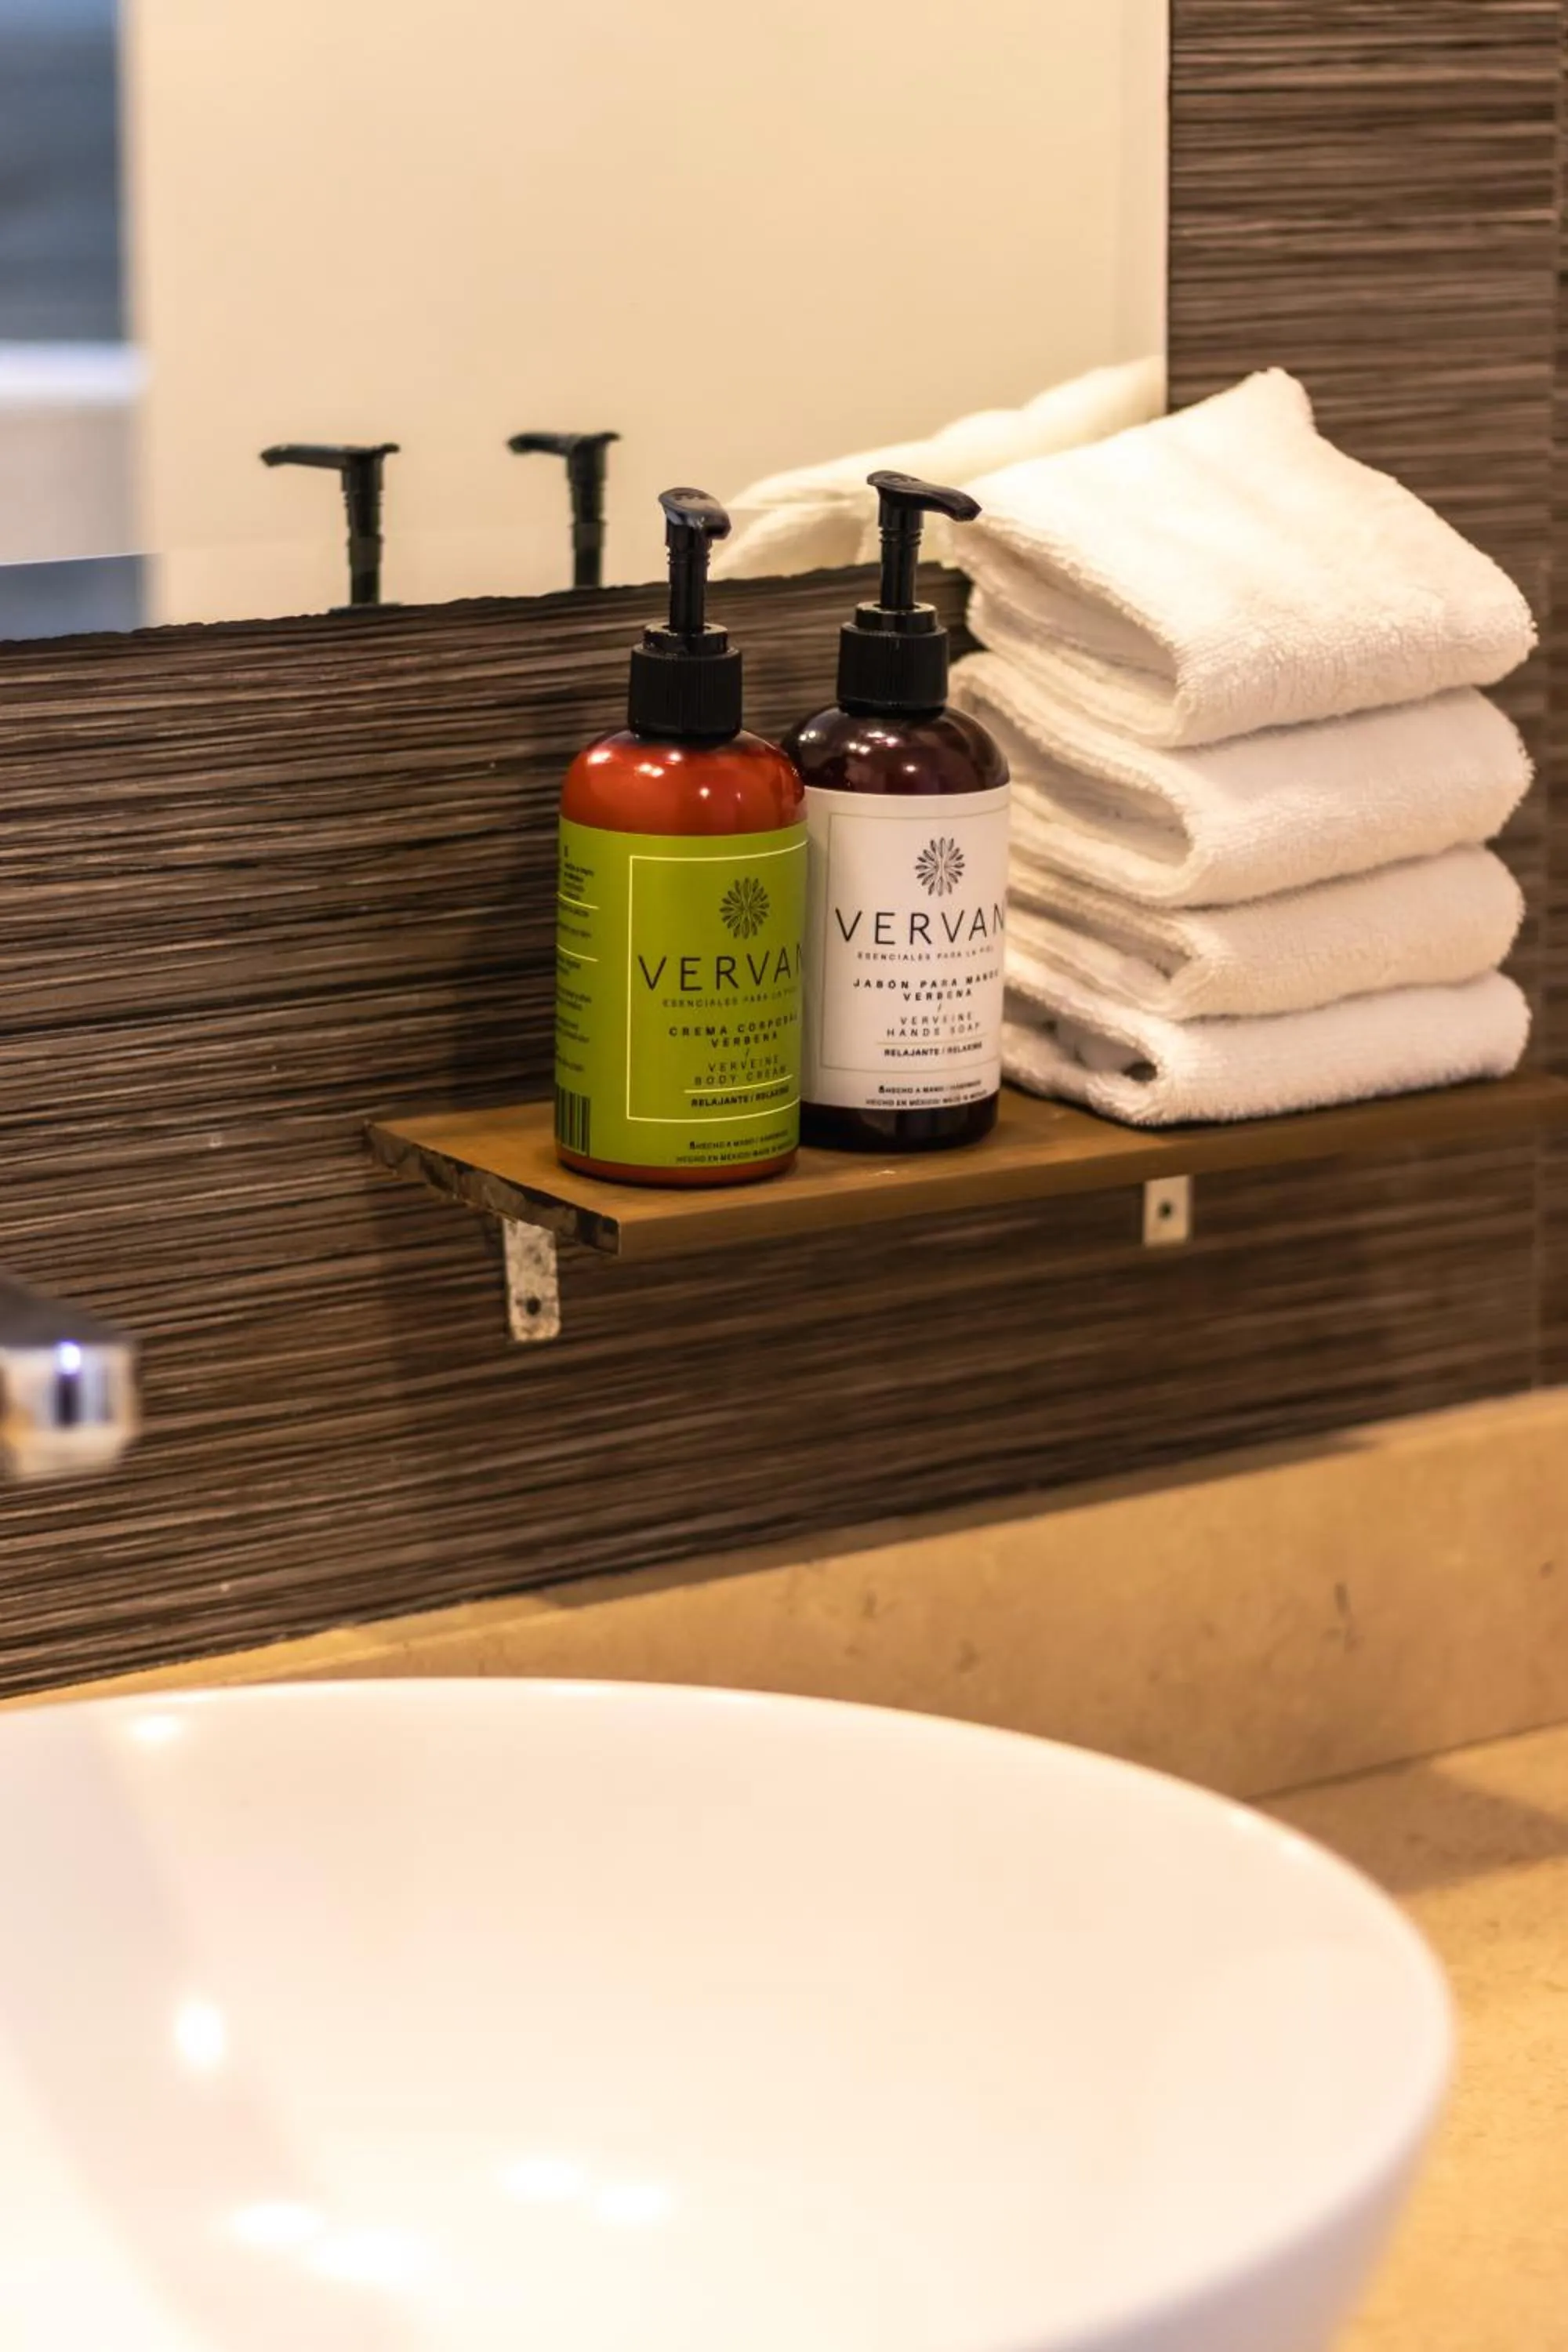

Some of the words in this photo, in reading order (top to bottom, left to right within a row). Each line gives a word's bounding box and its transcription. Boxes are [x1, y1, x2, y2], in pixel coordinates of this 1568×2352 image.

[903, 988, 972, 1001] VERBENA
[669, 1025, 728, 1036] CREMA
[711, 1031, 778, 1048] VERBENA
[884, 1047, 940, 1057] RELAJANTE
